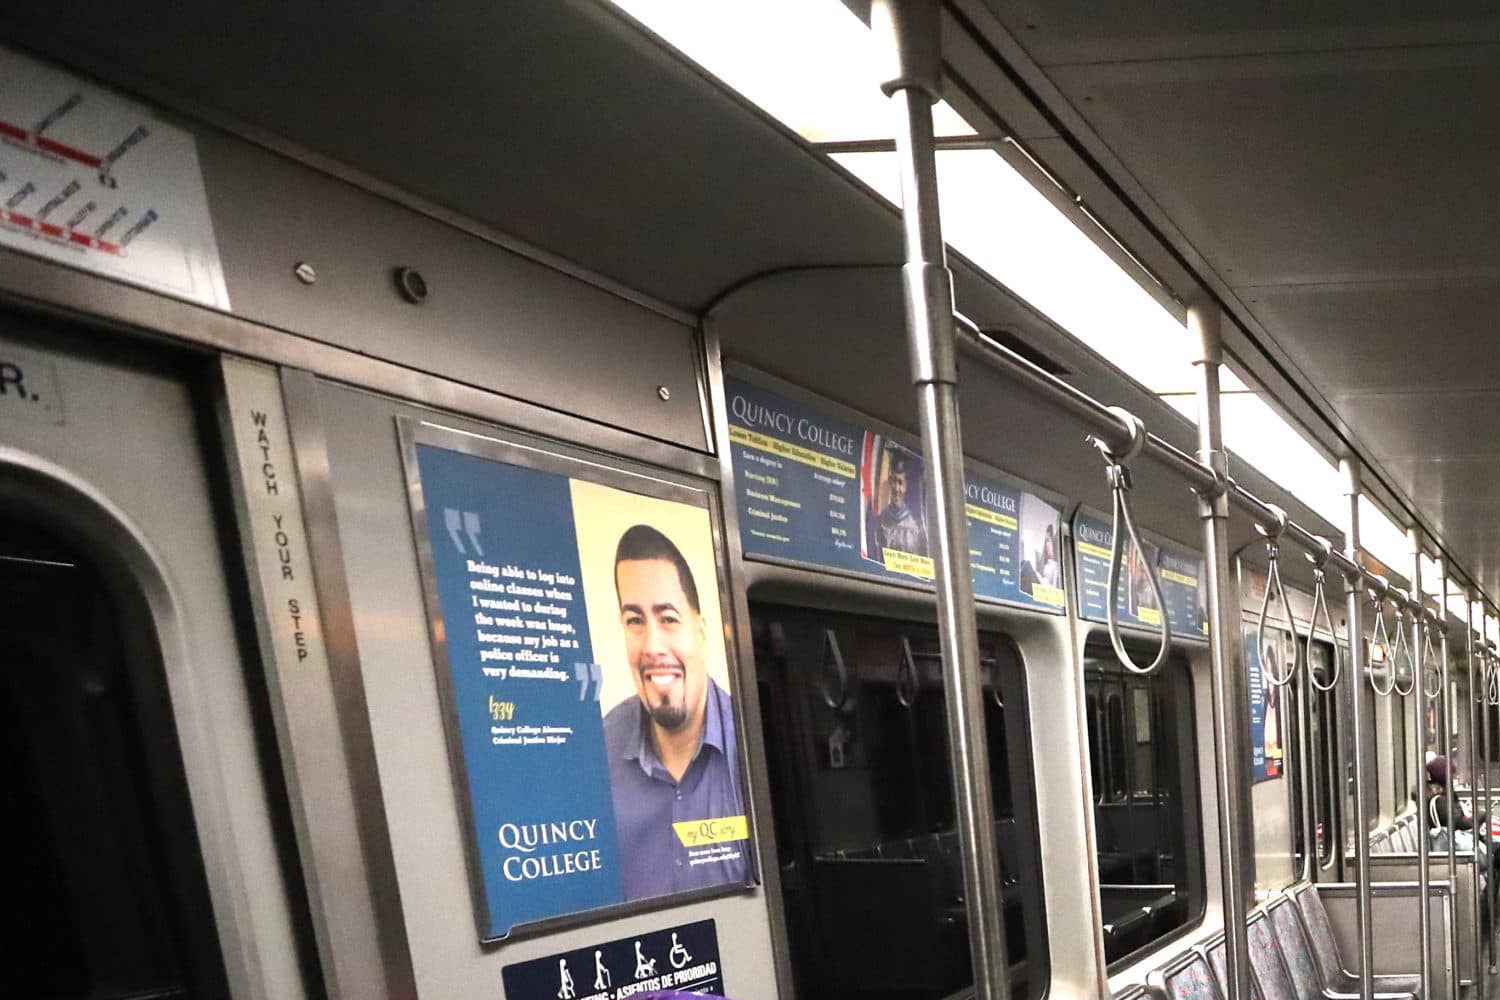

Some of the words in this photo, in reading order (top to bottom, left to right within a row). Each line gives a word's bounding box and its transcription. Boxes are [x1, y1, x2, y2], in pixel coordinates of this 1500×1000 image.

[732, 395, 795, 434] QUINCY
[798, 419, 854, 455] COLLEGE
[965, 483, 980, 500] NCY
[981, 487, 1016, 513] COLLEGE
[251, 409, 279, 495] WATCH
[272, 514, 294, 580] YOUR
[288, 599, 307, 662] STEP
[467, 559, 499, 577] Being
[502, 565, 524, 579] able
[526, 569, 537, 580] to
[538, 569, 555, 585] log
[556, 572, 575, 585] into
[470, 579, 504, 593] online
[506, 583, 544, 598] classes
[545, 587, 573, 600] when
[472, 595, 479, 607] I
[479, 597, 520, 611] wanted
[521, 601, 532, 612] to
[534, 602, 567, 618] during
[474, 612, 493, 626] the
[495, 616, 524, 629] week
[526, 621, 547, 630] was
[548, 619, 576, 634] huge,
[477, 629, 522, 644] because
[524, 636, 540, 649] my
[542, 635, 558, 649] job
[559, 639, 571, 648] as
[572, 640, 579, 648] a
[480, 648, 513, 662] police
[515, 649, 548, 662] officer
[550, 652, 560, 663] is
[482, 667, 507, 680] very
[509, 665, 570, 682] demanding.
[499, 818, 598, 852] QUINCY
[699, 822, 718, 840] QC
[503, 850, 602, 881] COLLEGE
[662, 975, 674, 989] DE
[674, 961, 717, 985] PRIORIDAD
